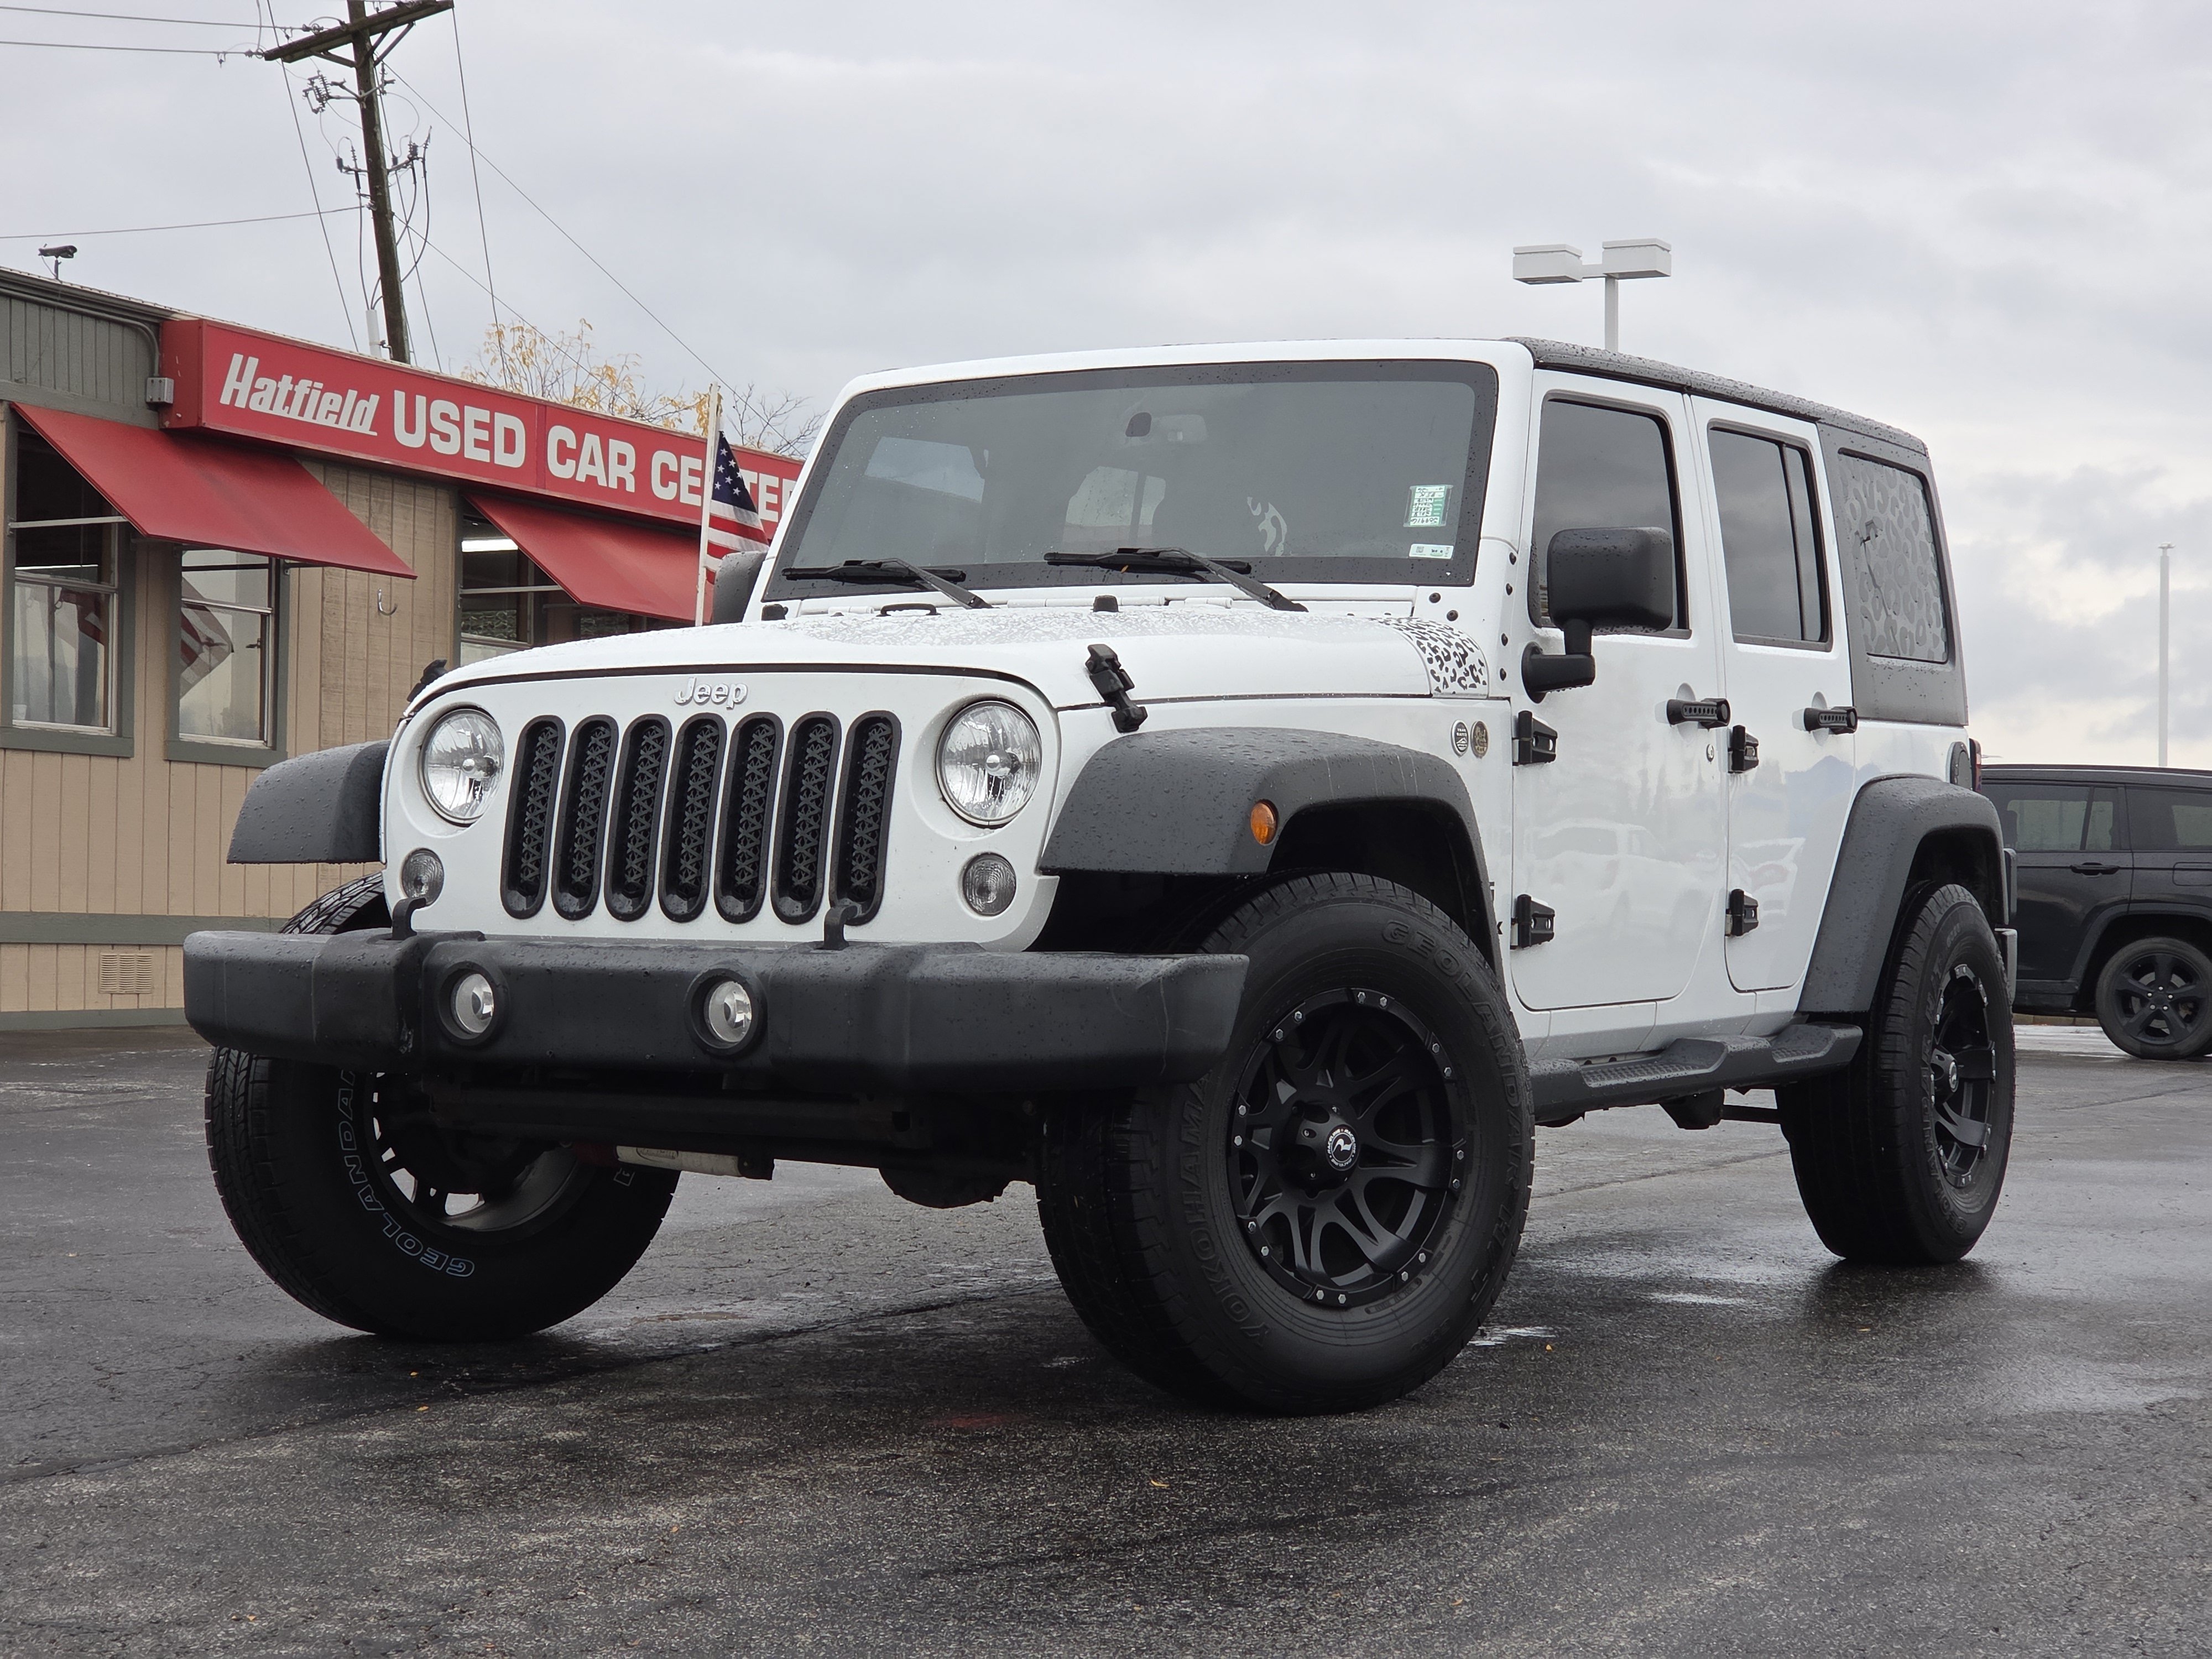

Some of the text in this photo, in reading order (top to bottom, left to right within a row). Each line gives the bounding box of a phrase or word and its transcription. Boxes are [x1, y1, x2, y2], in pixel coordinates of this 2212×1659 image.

[219, 353, 797, 523] Hatfield USED CAR CETE
[674, 676, 748, 711] Jeep
[1381, 918, 1523, 1191] GEOLANDAR
[337, 1069, 476, 1277] GEOLANDA
[1180, 1068, 1271, 1347] YOKOHAMA
